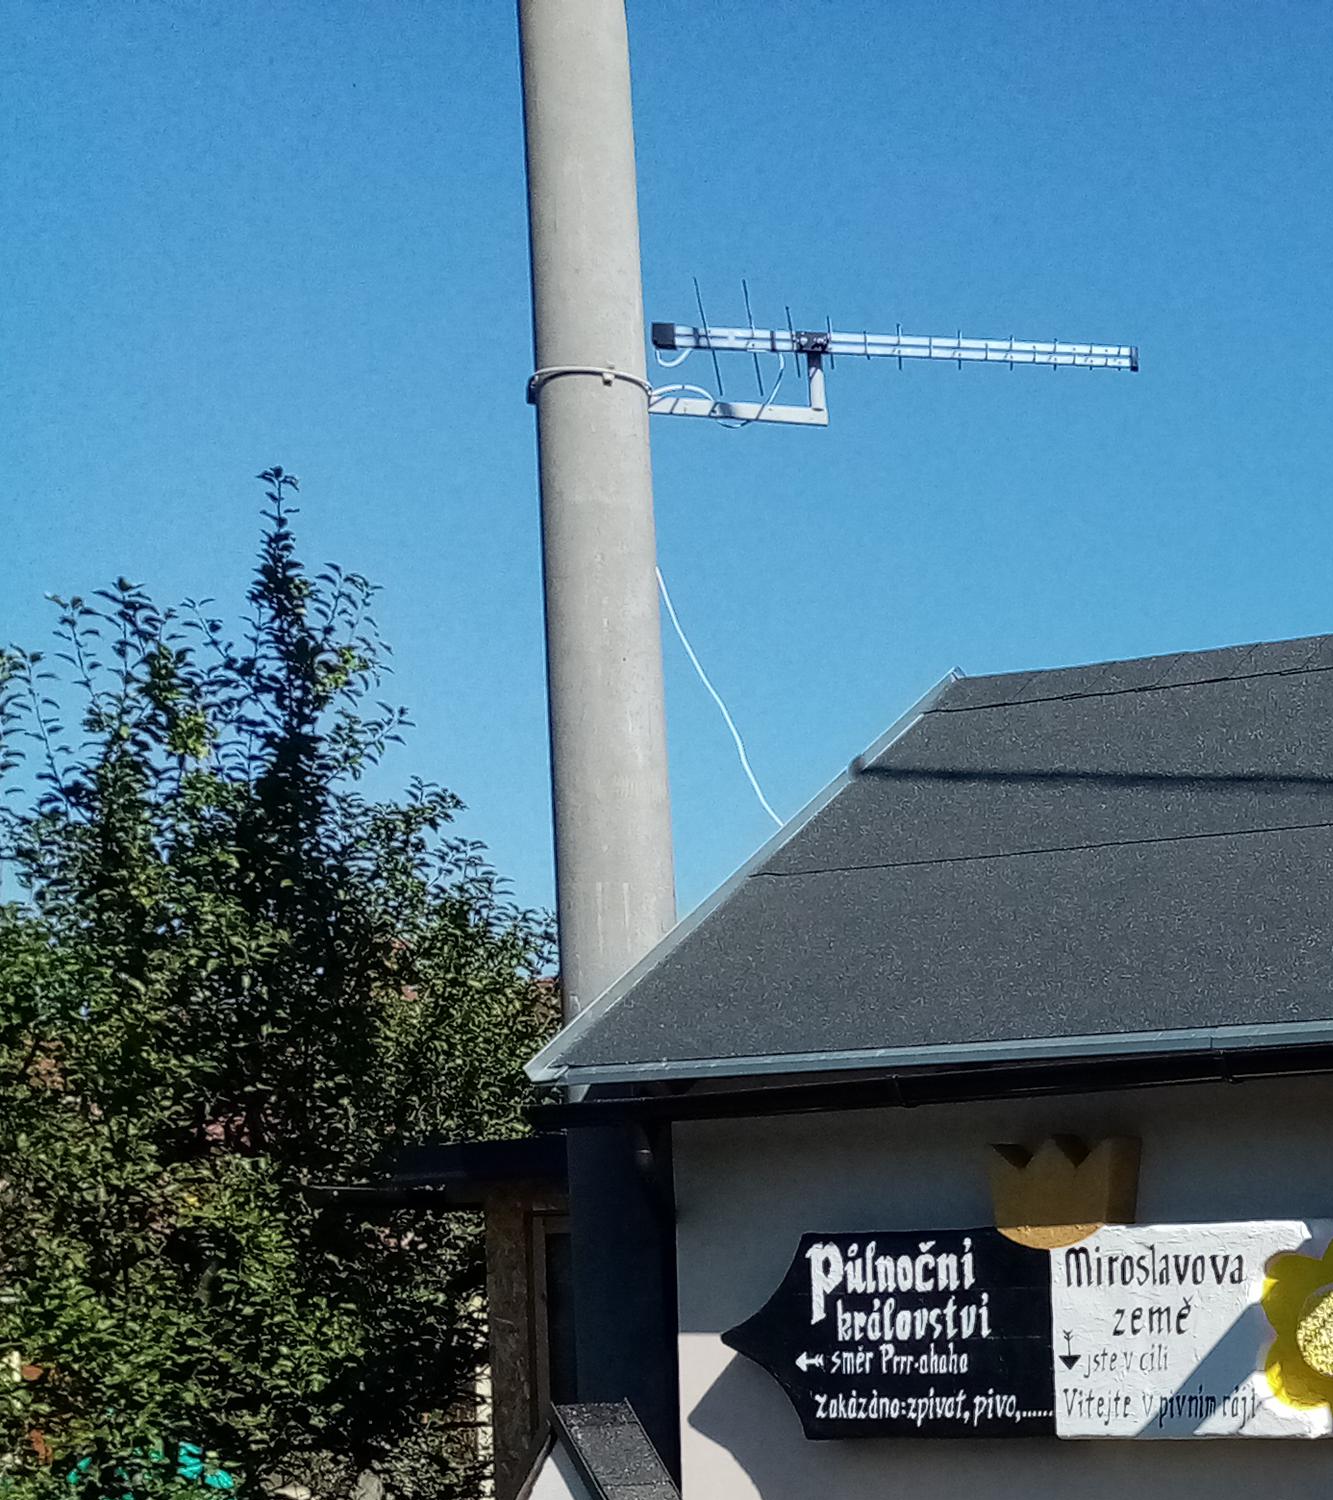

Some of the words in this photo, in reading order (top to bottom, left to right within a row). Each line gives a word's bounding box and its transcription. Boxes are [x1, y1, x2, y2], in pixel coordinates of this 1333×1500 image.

[806, 1239, 975, 1326] Půlnoční
[1065, 1245, 1246, 1288] Miroslavova
[836, 1292, 992, 1342] království
[1112, 1297, 1194, 1338] země
[830, 1345, 874, 1375] směr
[1083, 1348, 1118, 1378] jste
[1123, 1351, 1133, 1370] v
[1142, 1393, 1154, 1417] v
